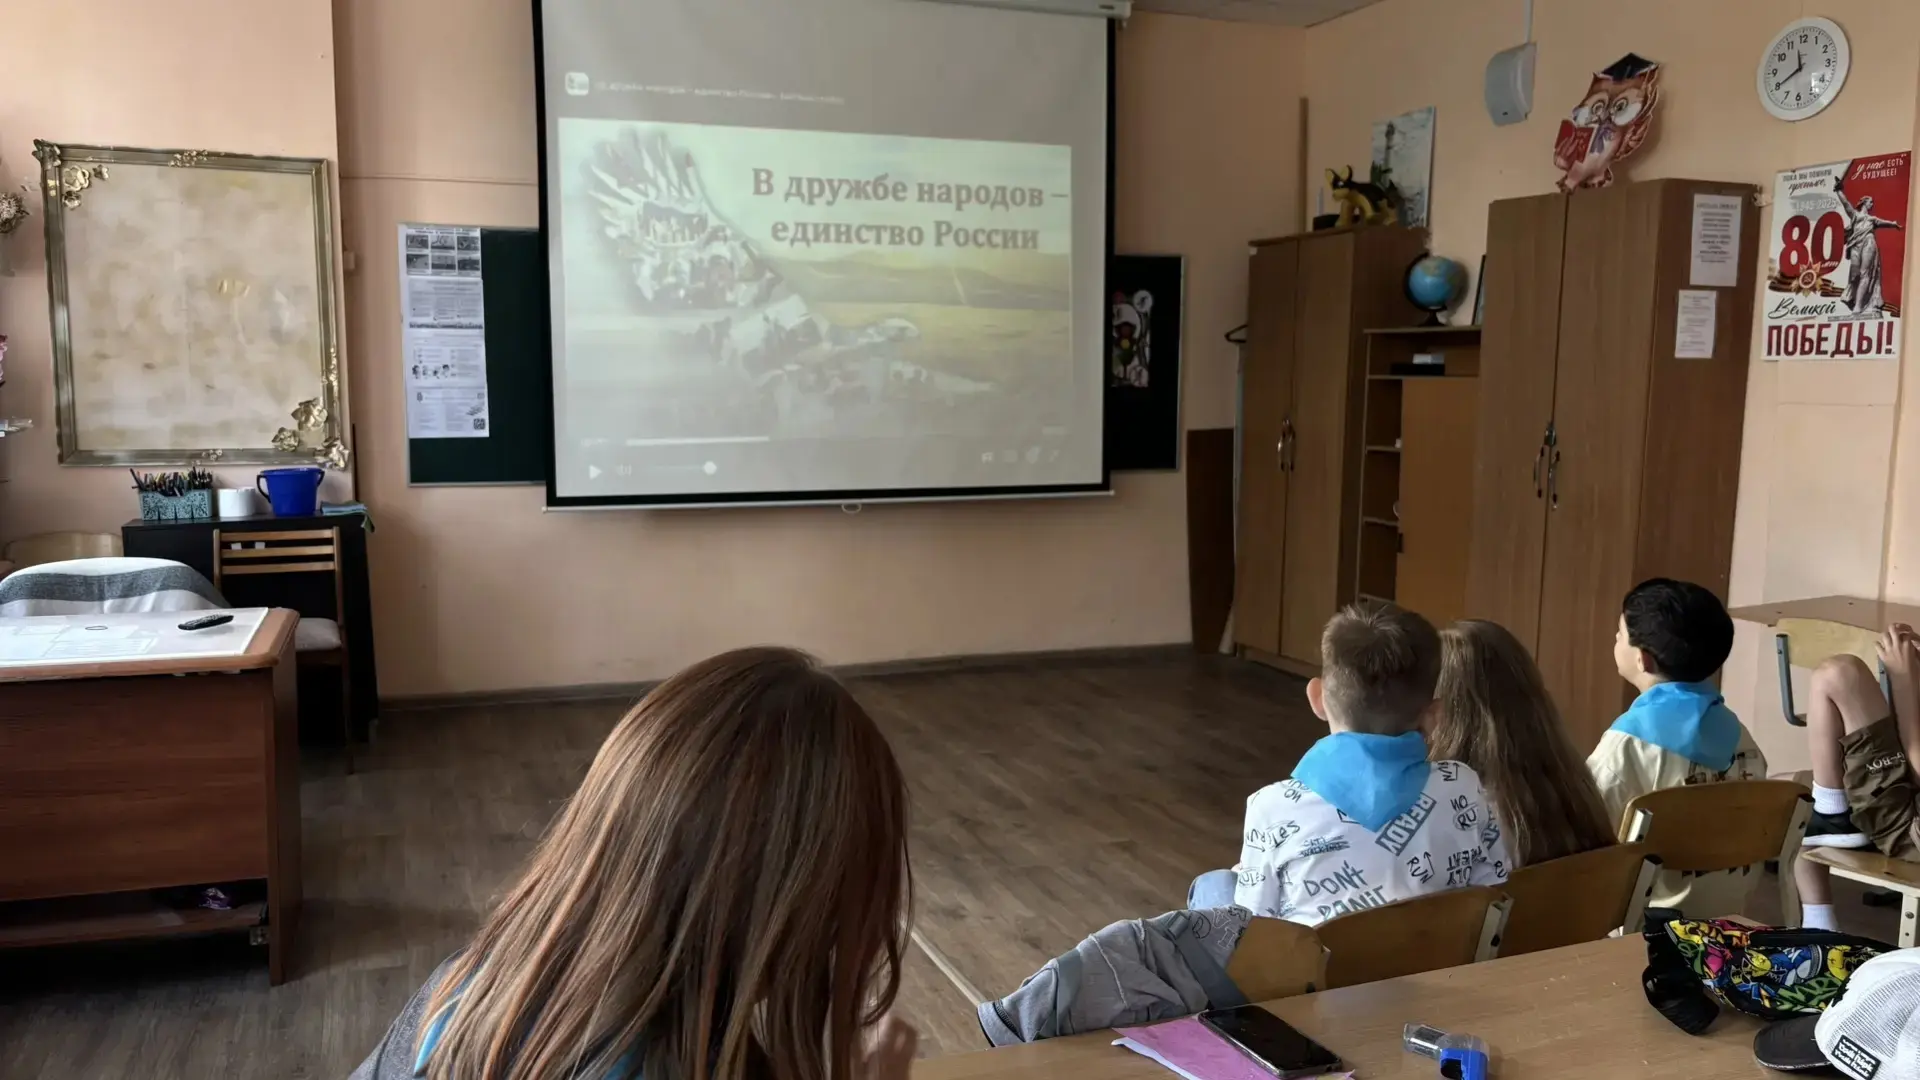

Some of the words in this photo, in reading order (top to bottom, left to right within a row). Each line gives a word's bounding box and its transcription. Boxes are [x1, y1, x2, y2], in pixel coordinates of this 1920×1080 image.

[1800, 34, 1809, 44] 12
[1787, 41, 1794, 50] 11
[1822, 44, 1828, 54] 2
[1777, 53, 1786, 62] 10
[1825, 58, 1831, 67] 3
[1772, 68, 1778, 77] 9
[1775, 82, 1781, 91] 8
[1784, 91, 1790, 100] 7
[1795, 92, 1801, 101] 6
[1887, 158, 1904, 167] ЕСТЬ
[1862, 168, 1897, 180] БУДУЩЕЕ!
[752, 168, 774, 195] В
[785, 171, 907, 205] дружбе
[917, 179, 1044, 210] народов
[771, 221, 925, 247] единство
[933, 221, 1040, 250] России
[1779, 211, 1846, 277] 80
[1768, 297, 1836, 320] Великой
[1766, 321, 1895, 358] ПОБЕДЫ!
[1407, 856, 1434, 884] RUN
